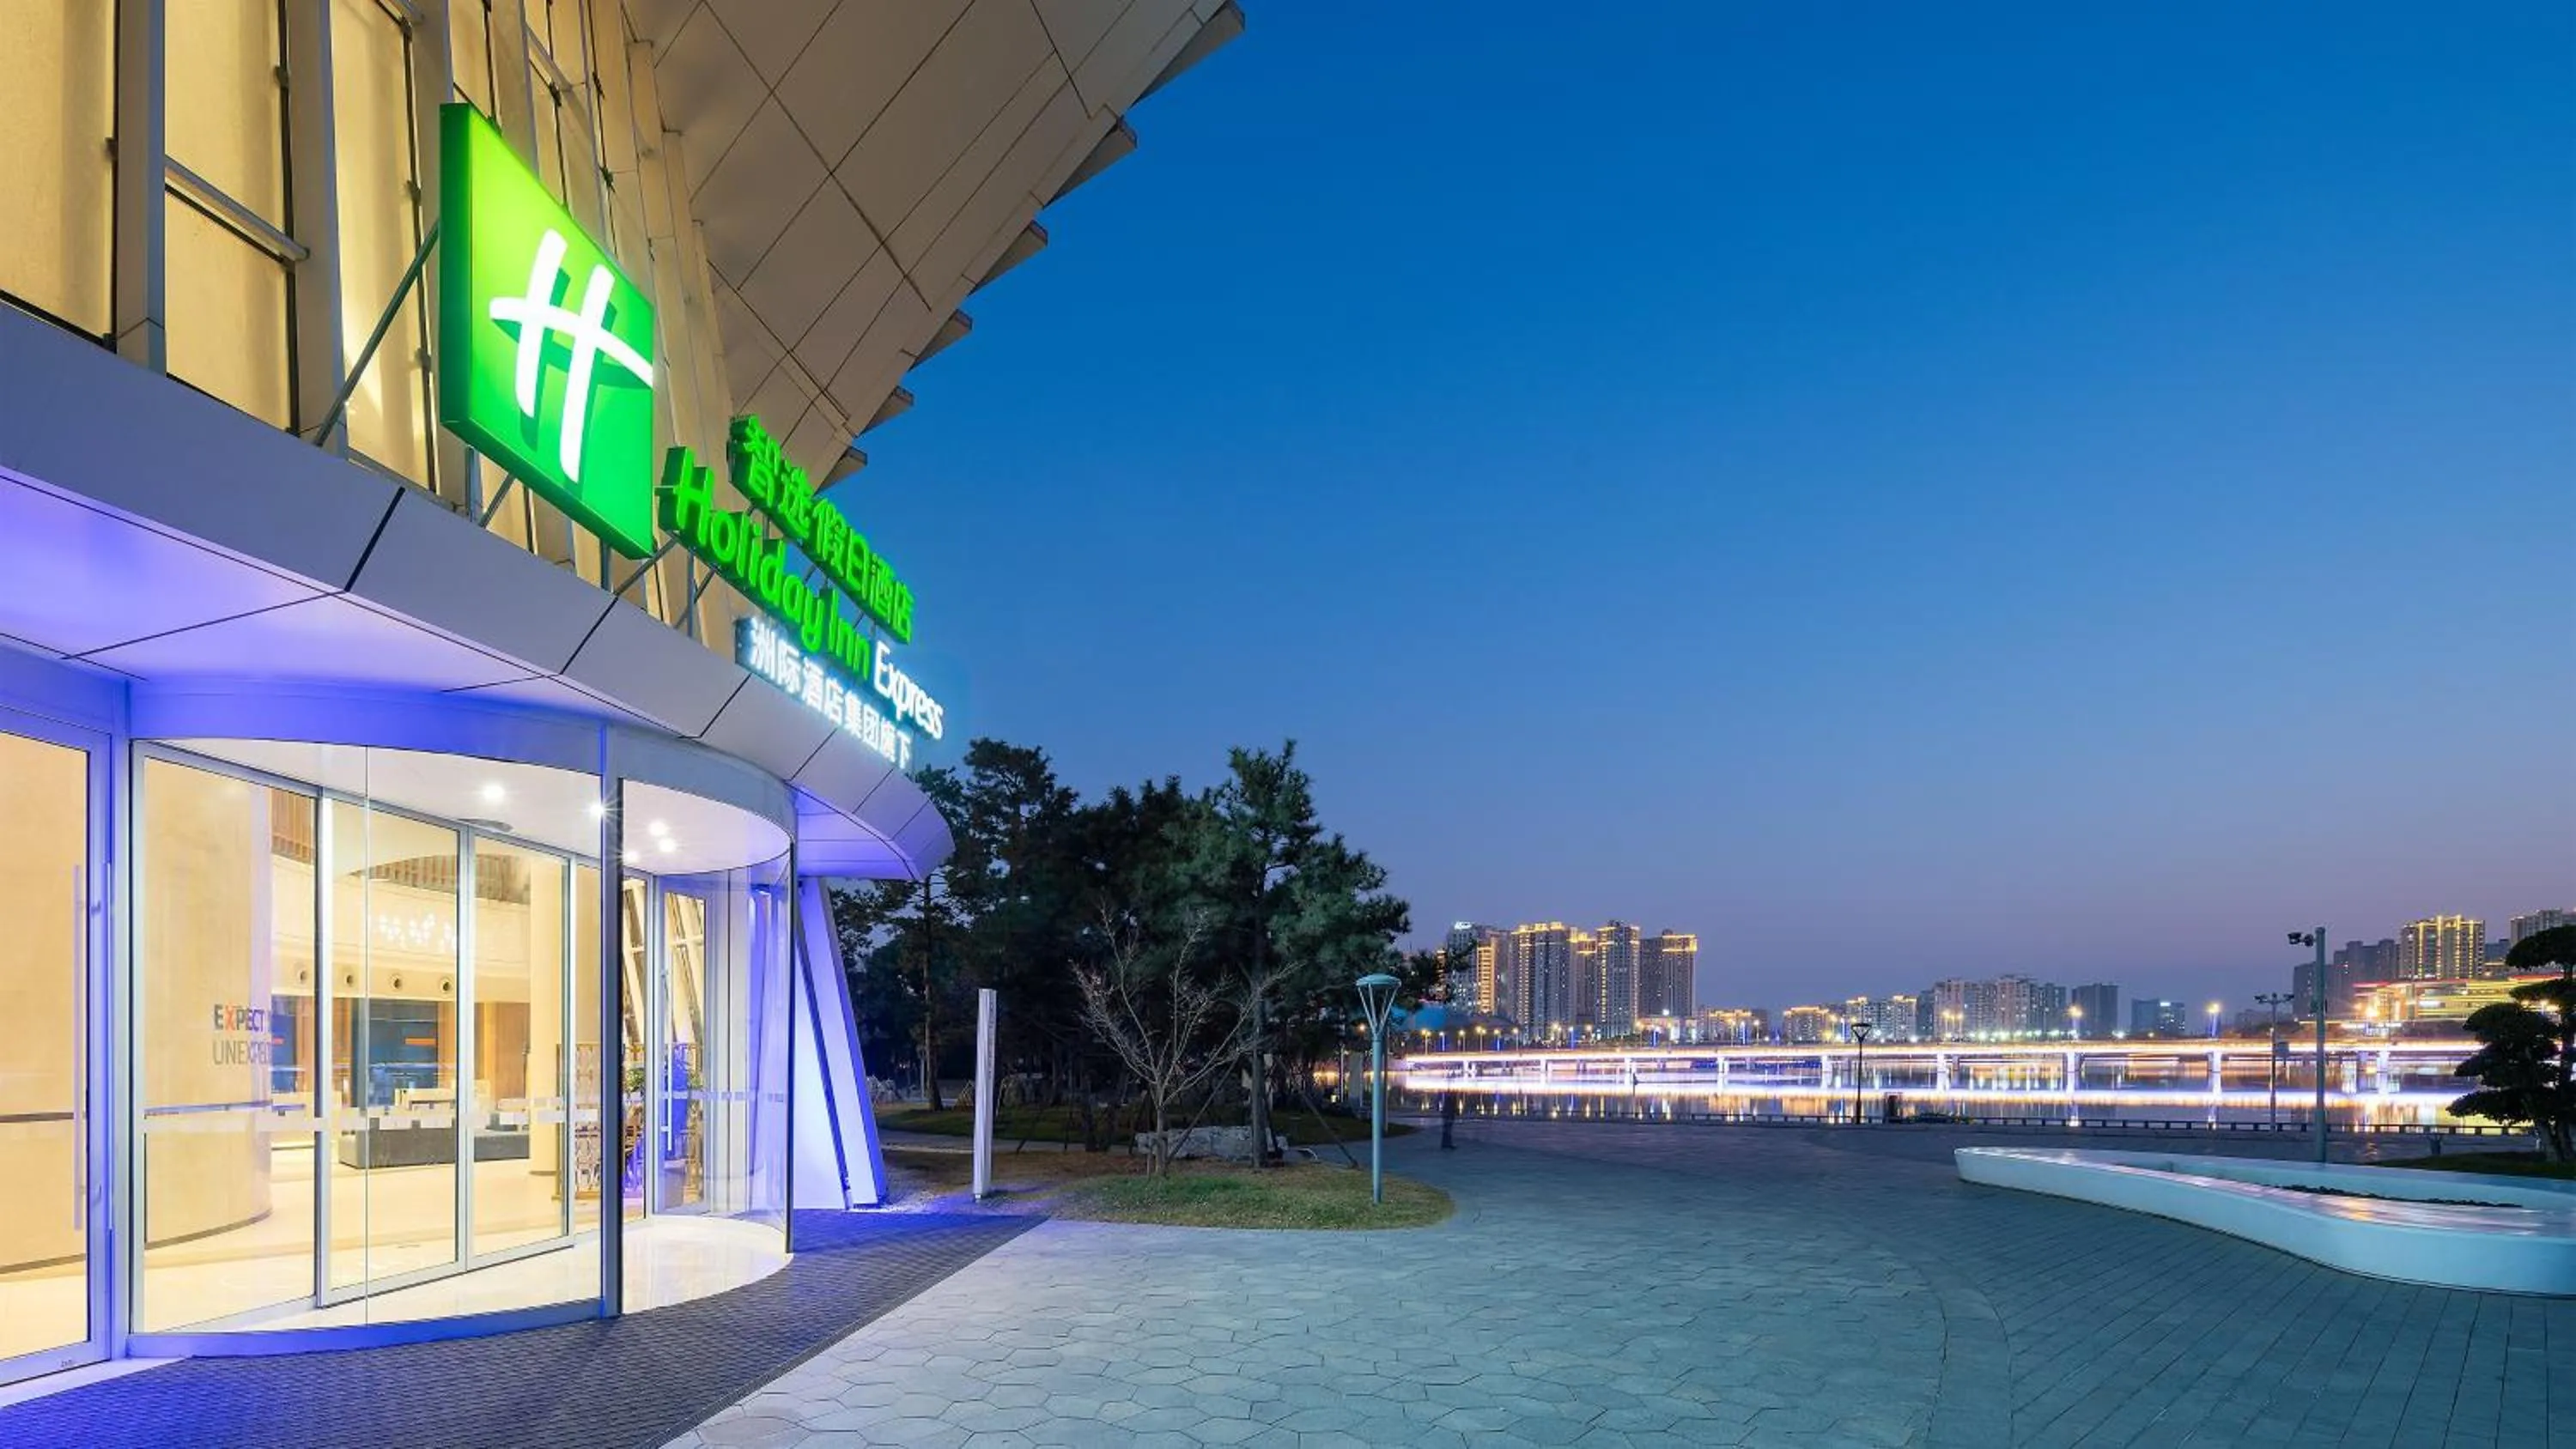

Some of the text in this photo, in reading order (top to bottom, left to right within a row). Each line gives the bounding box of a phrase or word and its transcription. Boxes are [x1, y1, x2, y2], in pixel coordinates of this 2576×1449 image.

[671, 446, 944, 740] Holiday Inn Express
[742, 415, 914, 644] 智选假日酒店
[750, 616, 911, 769] 洲际酒店集团旗下
[214, 1003, 264, 1032] EXPECT
